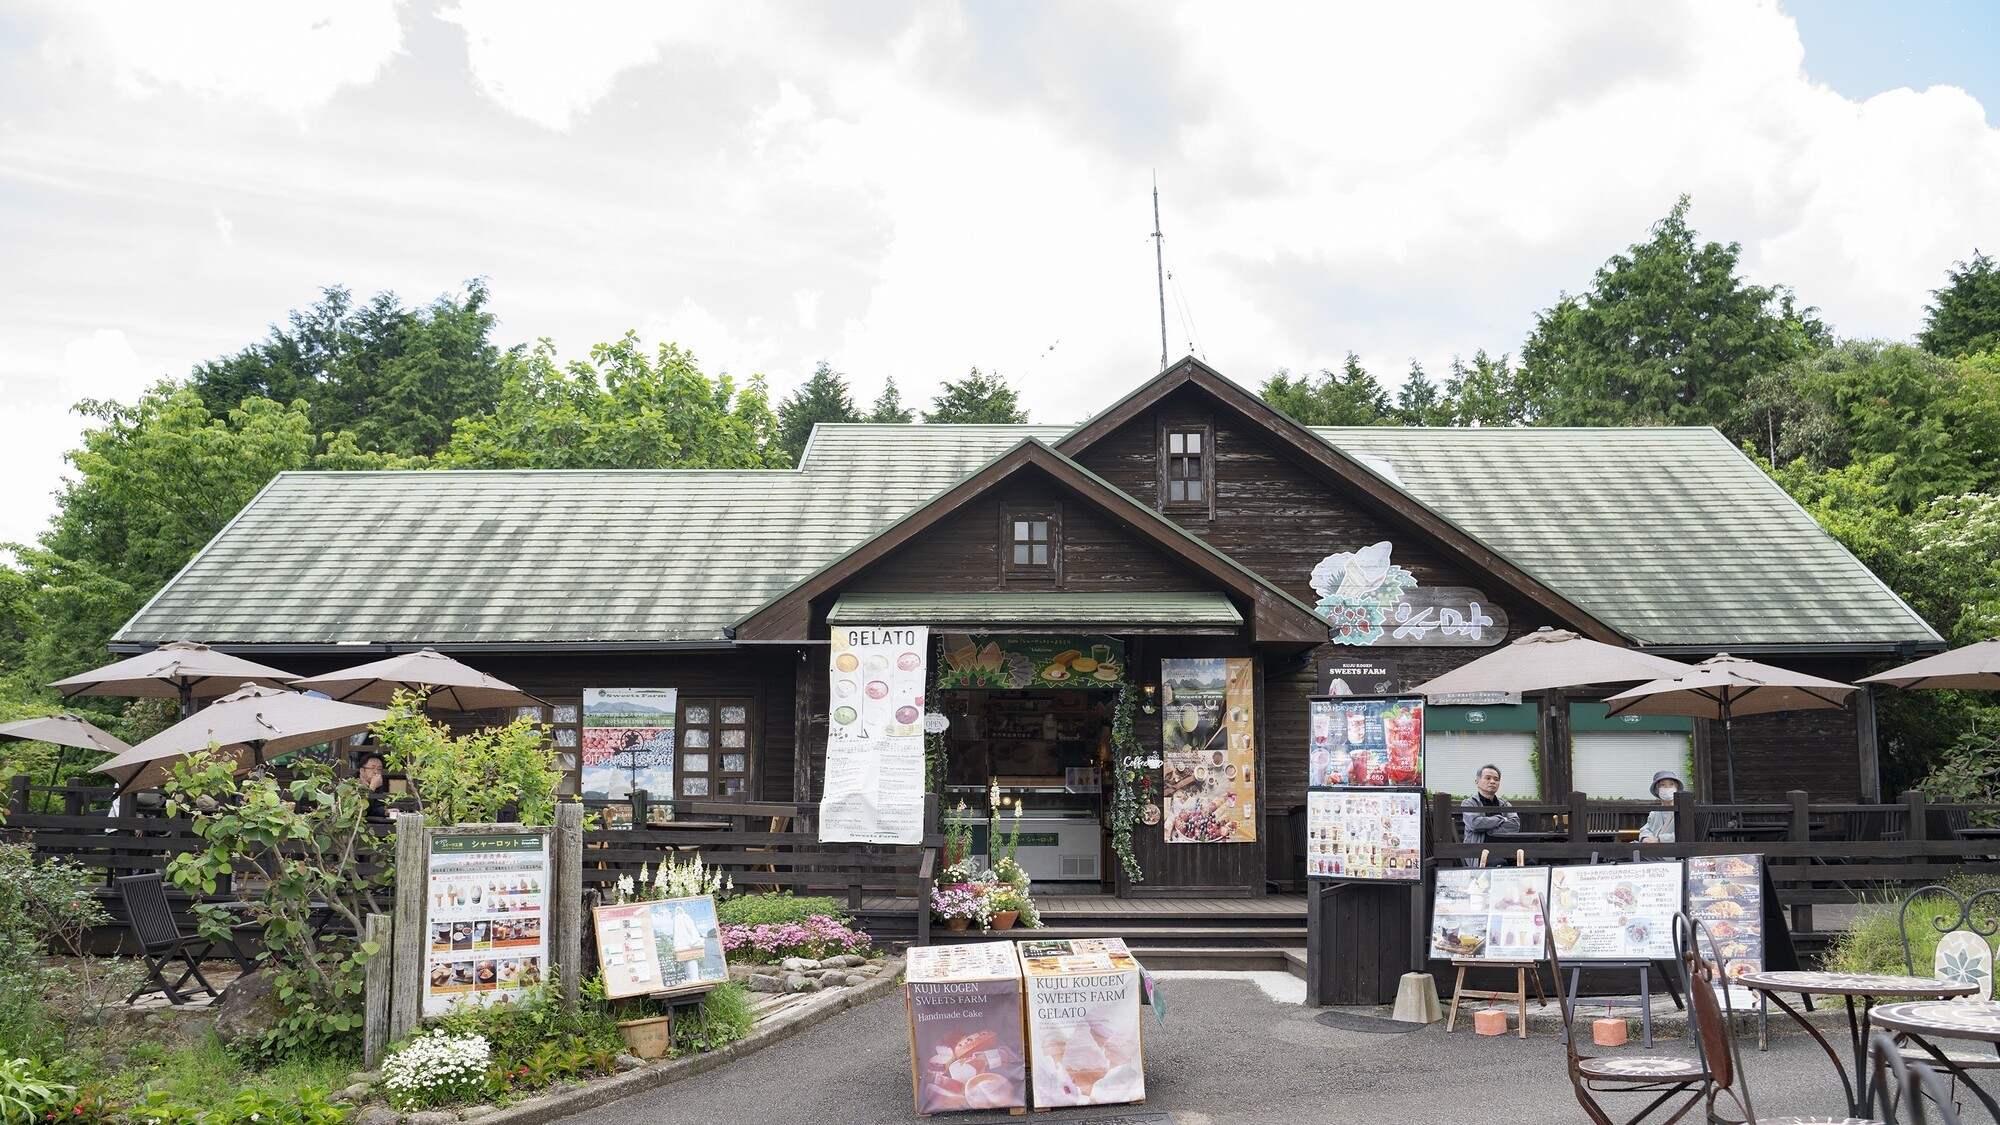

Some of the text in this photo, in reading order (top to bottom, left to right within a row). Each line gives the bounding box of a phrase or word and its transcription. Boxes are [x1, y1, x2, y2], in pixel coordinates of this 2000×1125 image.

[1393, 602, 1493, 640] シャーロット
[848, 630, 915, 647] GELATO
[925, 720, 943, 728] OPEN
[1123, 755, 1148, 769] Coffee
[471, 839, 519, 848] シャーロット
[914, 982, 979, 994] KUJU KOGEN
[1036, 974, 1125, 989] KUJU KOUGEN
[915, 994, 988, 1006] SWEETS FARM
[1037, 989, 1125, 1004] SWEETS FARM
[917, 1010, 983, 1022] Handmade Cake
[1038, 1006, 1087, 1020] GELATO
